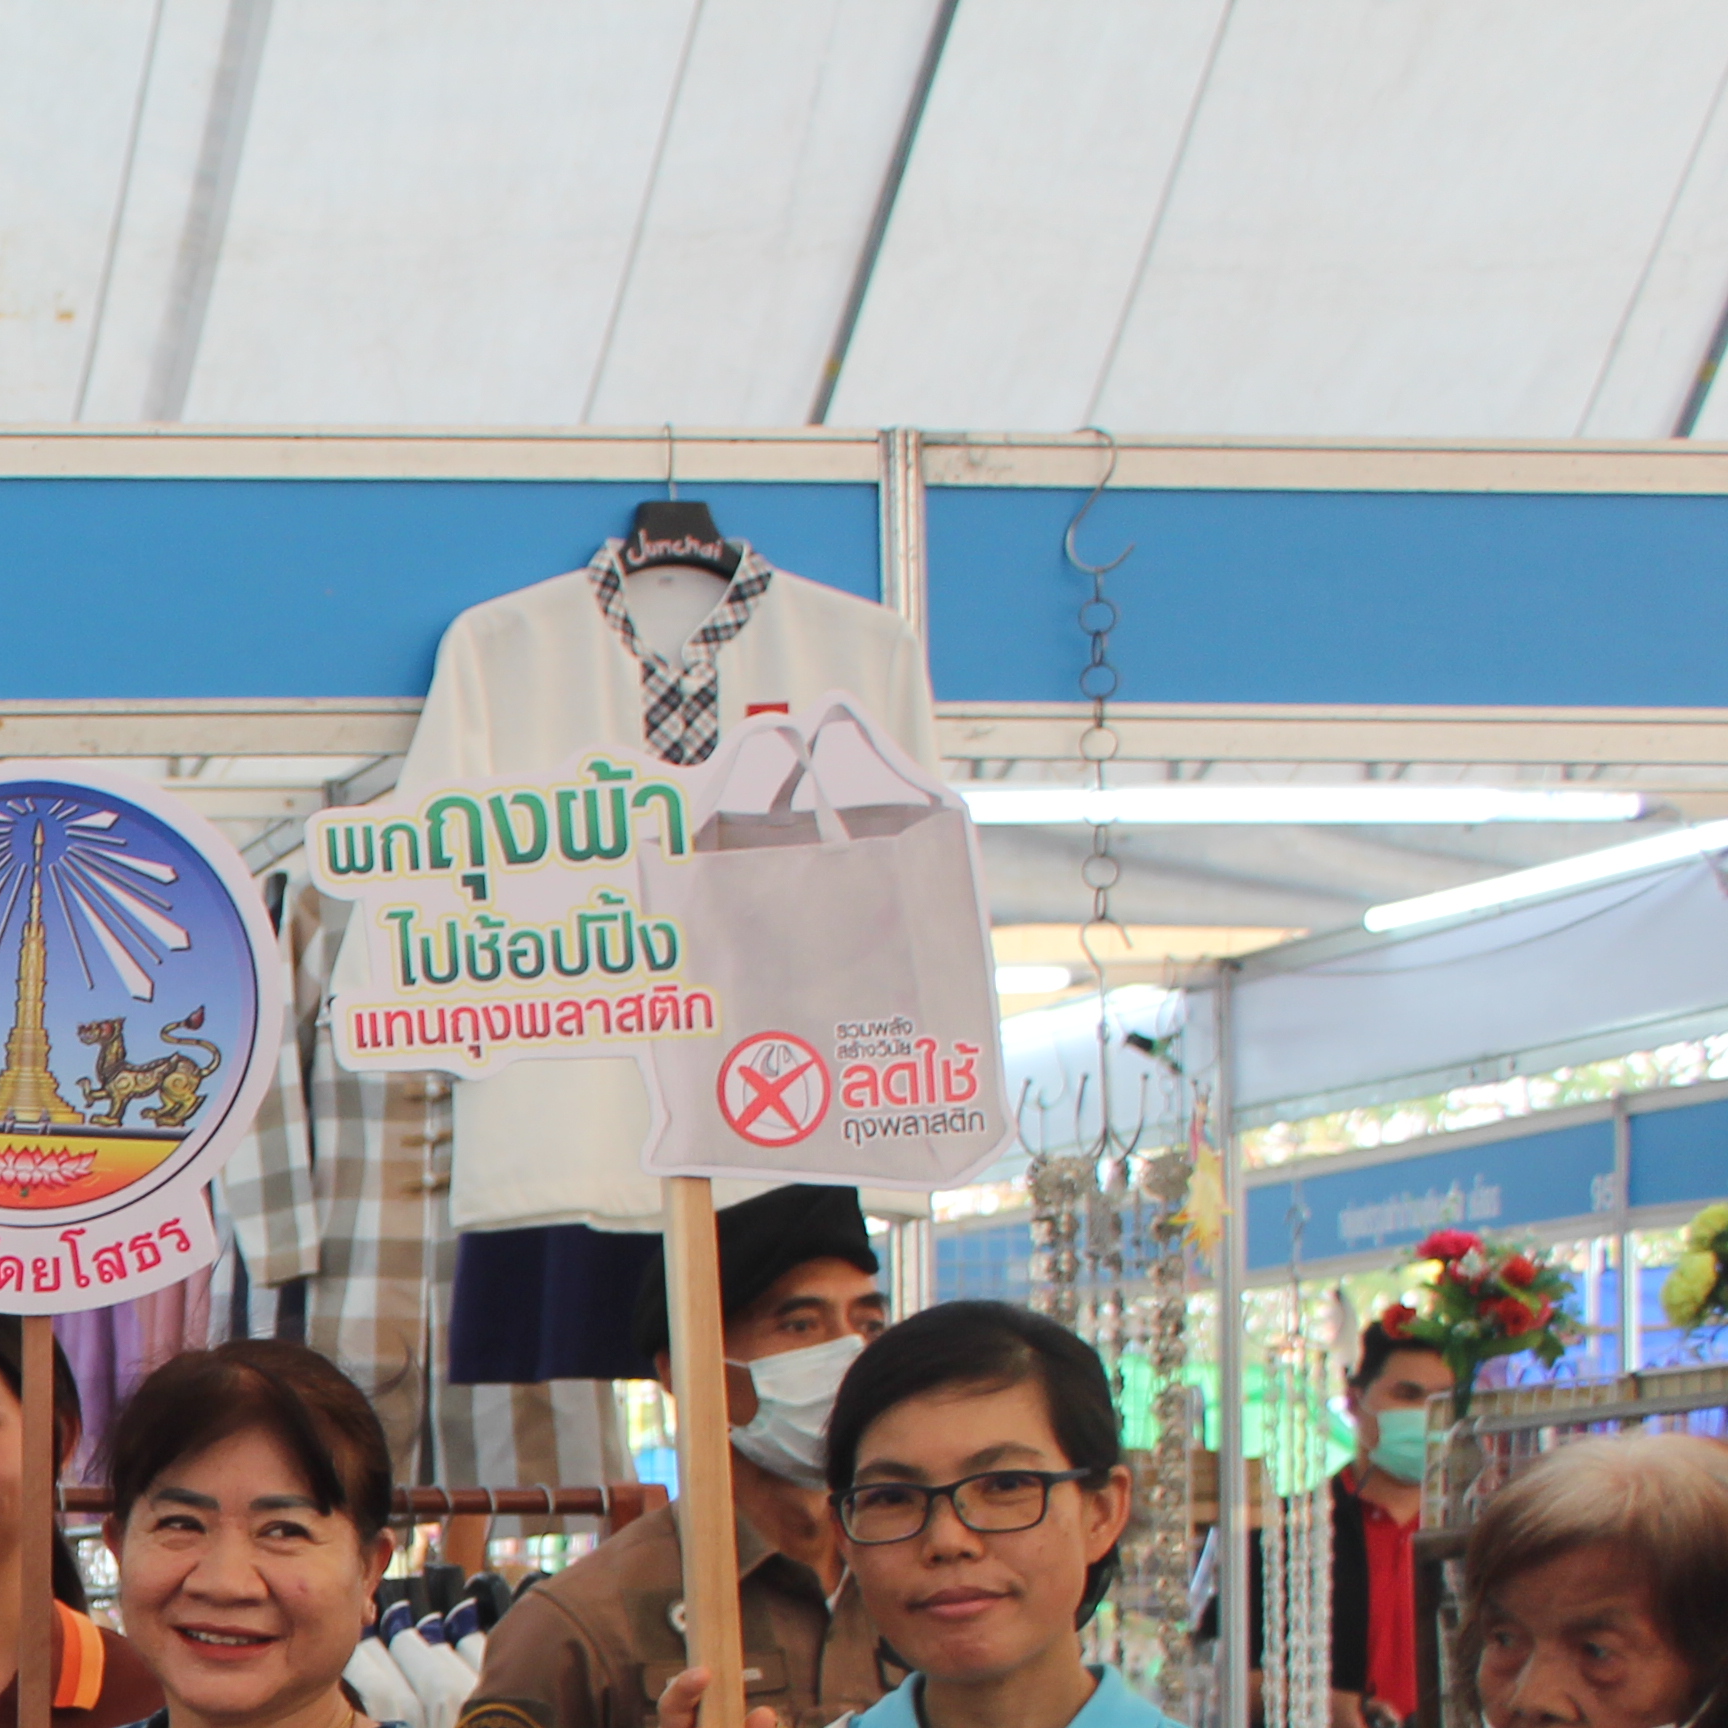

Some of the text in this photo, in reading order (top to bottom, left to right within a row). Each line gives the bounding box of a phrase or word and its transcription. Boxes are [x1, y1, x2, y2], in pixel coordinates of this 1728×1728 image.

[327, 760, 686, 900] พกถุงผ้า
[386, 891, 680, 985] ไปช้อปปิ้ง
[354, 985, 714, 1059] แทนถุงพลาสติก
[842, 1038, 979, 1108] ลดใช้
[844, 1107, 984, 1146] ถุงพลาสติก
